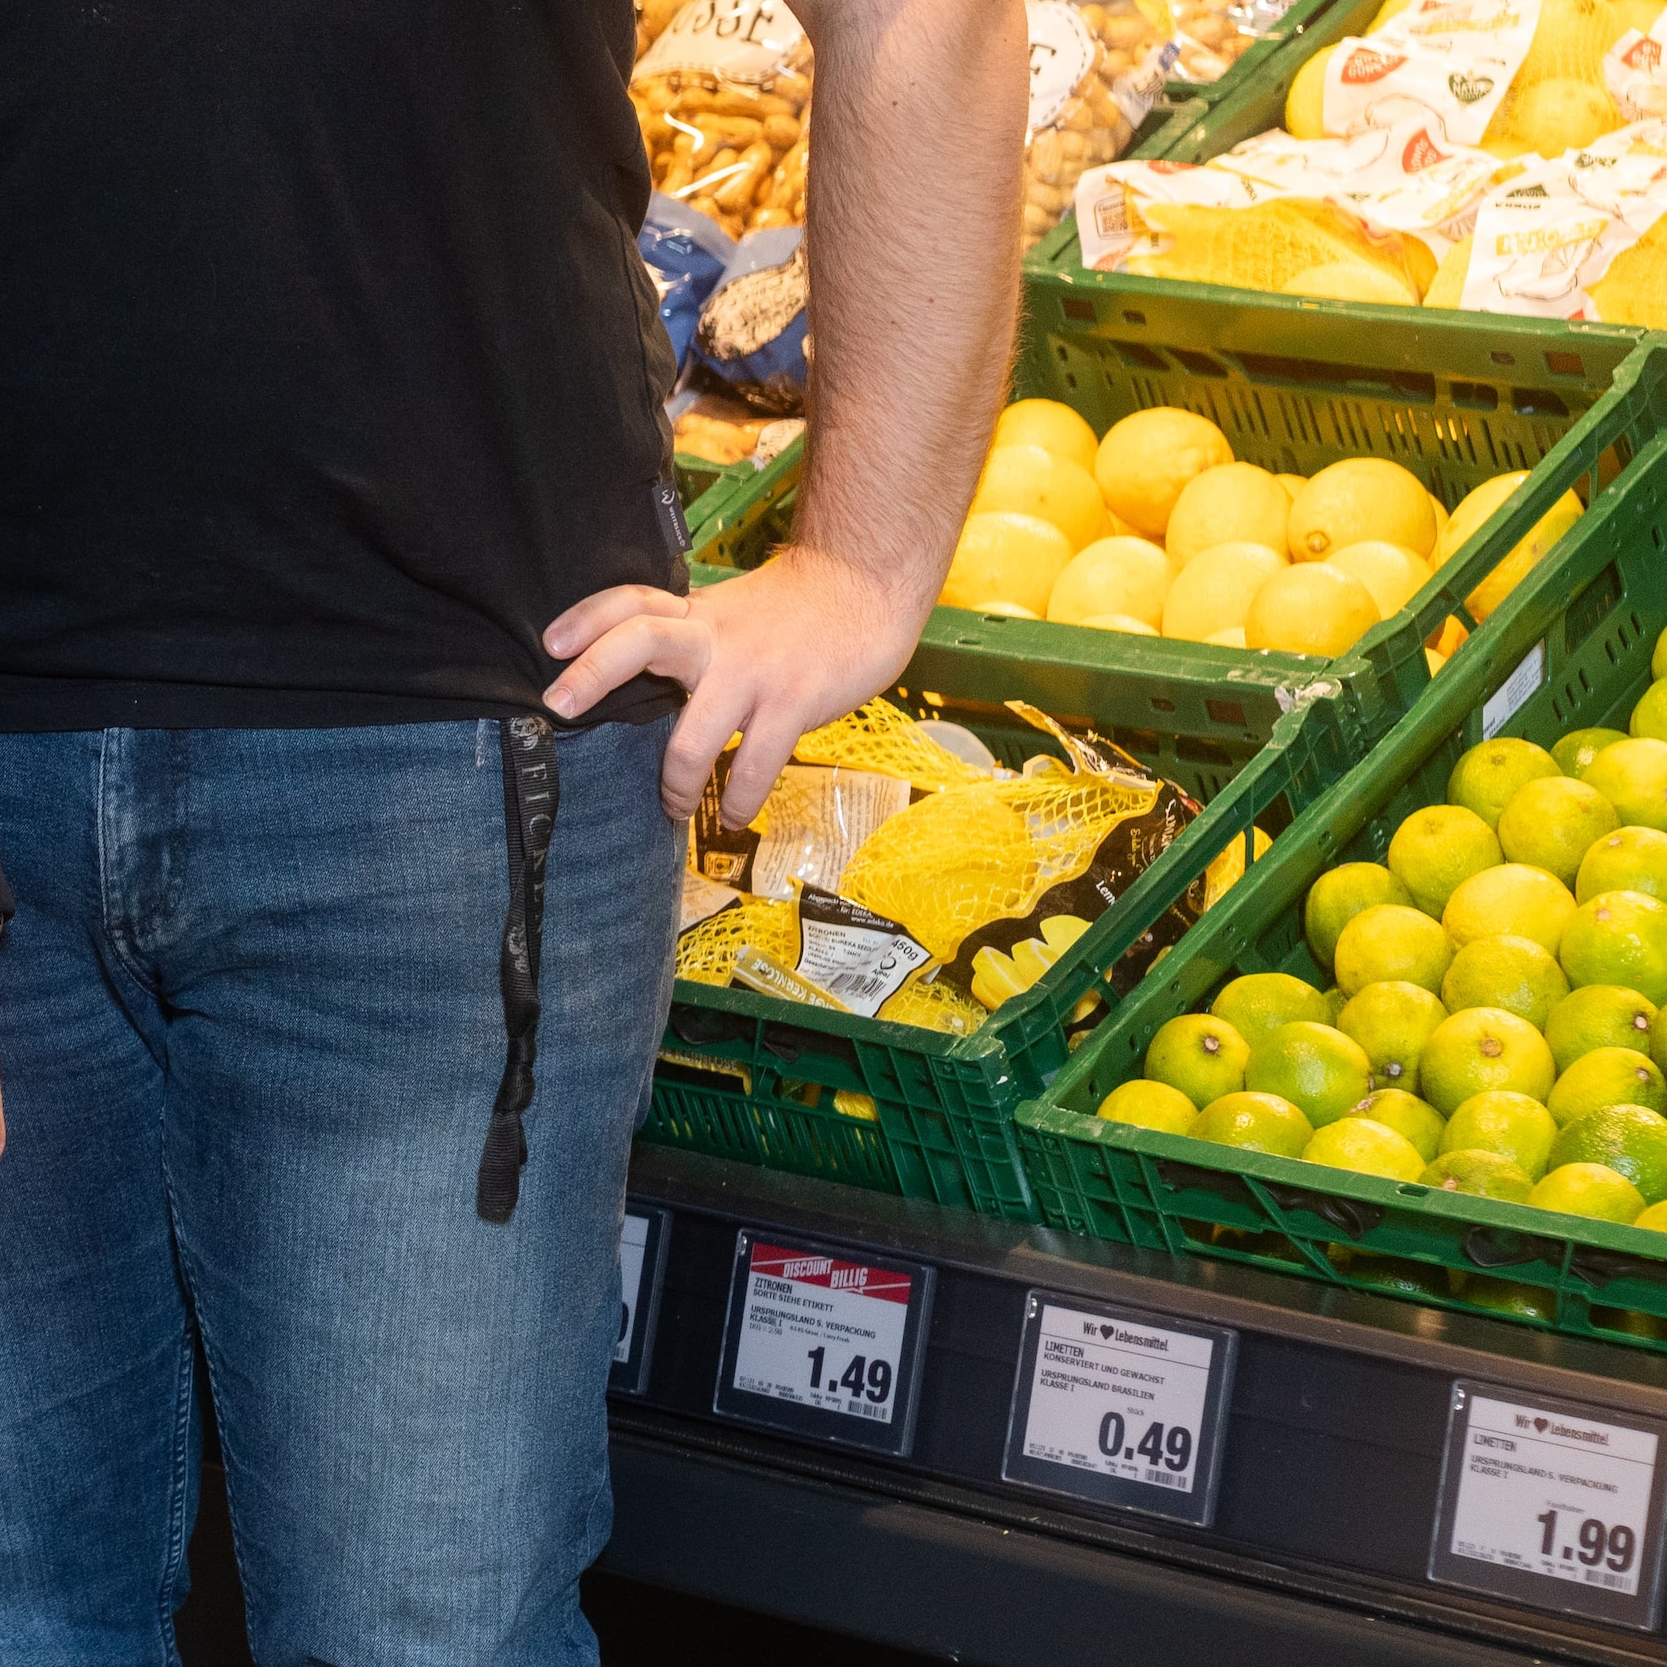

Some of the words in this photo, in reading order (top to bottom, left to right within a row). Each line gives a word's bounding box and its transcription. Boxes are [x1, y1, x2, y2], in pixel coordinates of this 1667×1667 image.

[755, 1277, 793, 1295] ZITRONEN
[783, 1259, 834, 1279] DISCOUNT
[830, 1267, 869, 1290] BILLIG
[753, 1289, 778, 1303] SORTE
[779, 1294, 802, 1307] SIEHE
[803, 1299, 835, 1313] ETIKETT
[751, 1305, 817, 1326] URSPRUNGSLAND
[826, 1321, 877, 1340] VERPACKUNG
[1083, 1321, 1099, 1337] Wir
[1115, 1329, 1170, 1352] Lebensmittel.
[1045, 1340, 1085, 1359] LIMETTEN
[808, 1346, 892, 1404] 1.49
[1043, 1352, 1100, 1371] KONSERVIERT
[1101, 1364, 1119, 1375] UND
[1120, 1369, 1165, 1385] GEWACHST
[1040, 1378, 1069, 1392] KLASSE
[1041, 1369, 1111, 1391] URSPRUNGSLAND
[1111, 1385, 1156, 1401] BRASILIEN
[1127, 1406, 1146, 1417] Stück
[1515, 1413, 1532, 1430] Wir
[1098, 1411, 1193, 1473] 0.49
[1473, 1433, 1517, 1453] LIMETTEN
[1470, 1464, 1503, 1479] KLASSE
[1471, 1454, 1547, 1478] URSPRUNGSLAND
[1559, 1473, 1619, 1494] VERPACKUNG
[1537, 1509, 1636, 1573] 1.99
